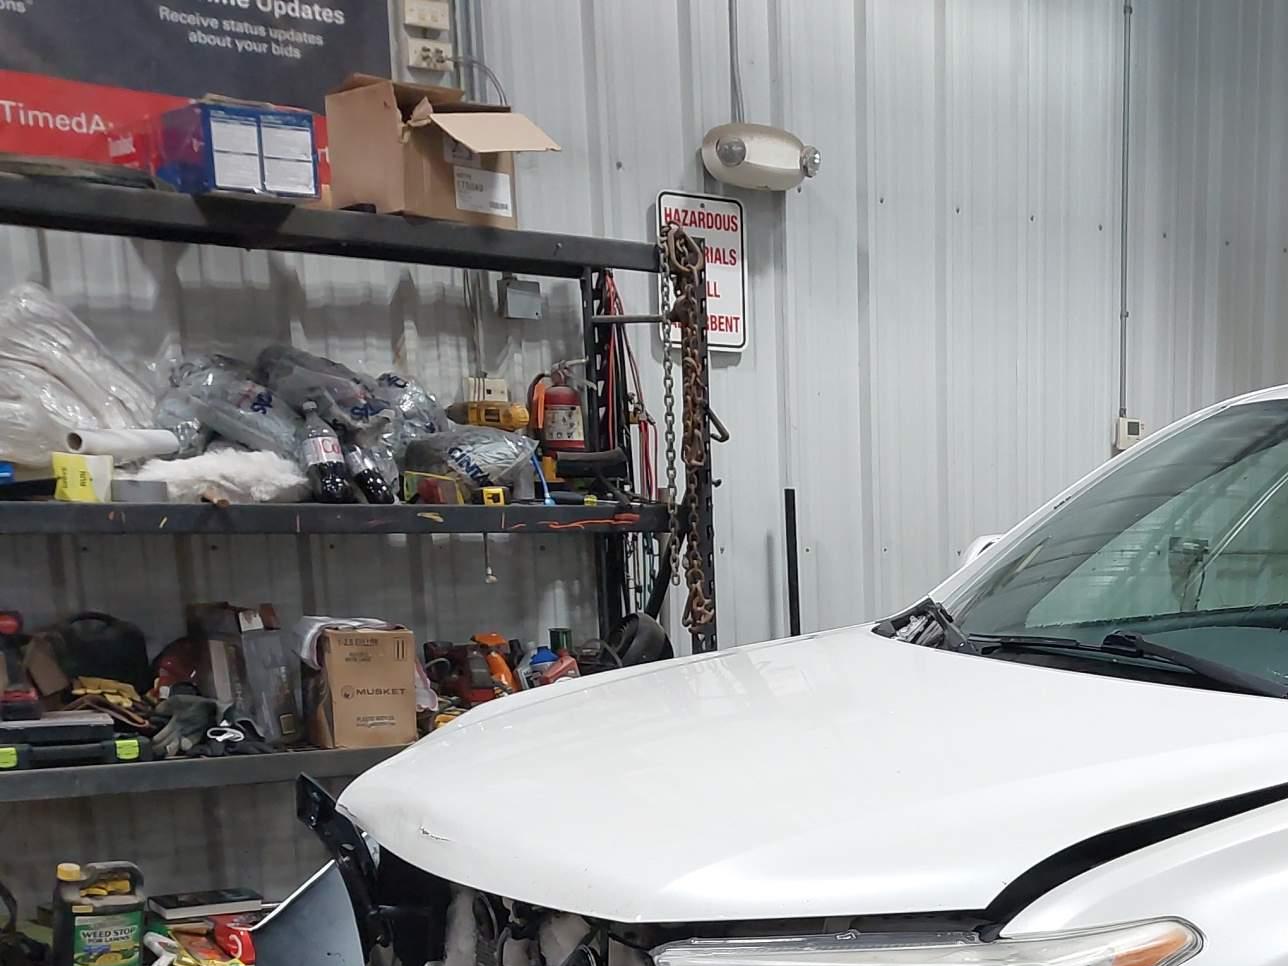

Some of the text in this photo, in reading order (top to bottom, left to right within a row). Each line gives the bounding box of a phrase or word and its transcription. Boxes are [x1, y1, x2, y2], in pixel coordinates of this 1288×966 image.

[256, 0, 344, 24] Updates
[159, 6, 323, 46] Receive status updates
[188, 30, 302, 58] about your bids
[0, 100, 113, 134] TimedA
[664, 207, 738, 232] HAZARDOUS
[356, 688, 406, 696] MUSKET
[82, 930, 112, 938] WEED
